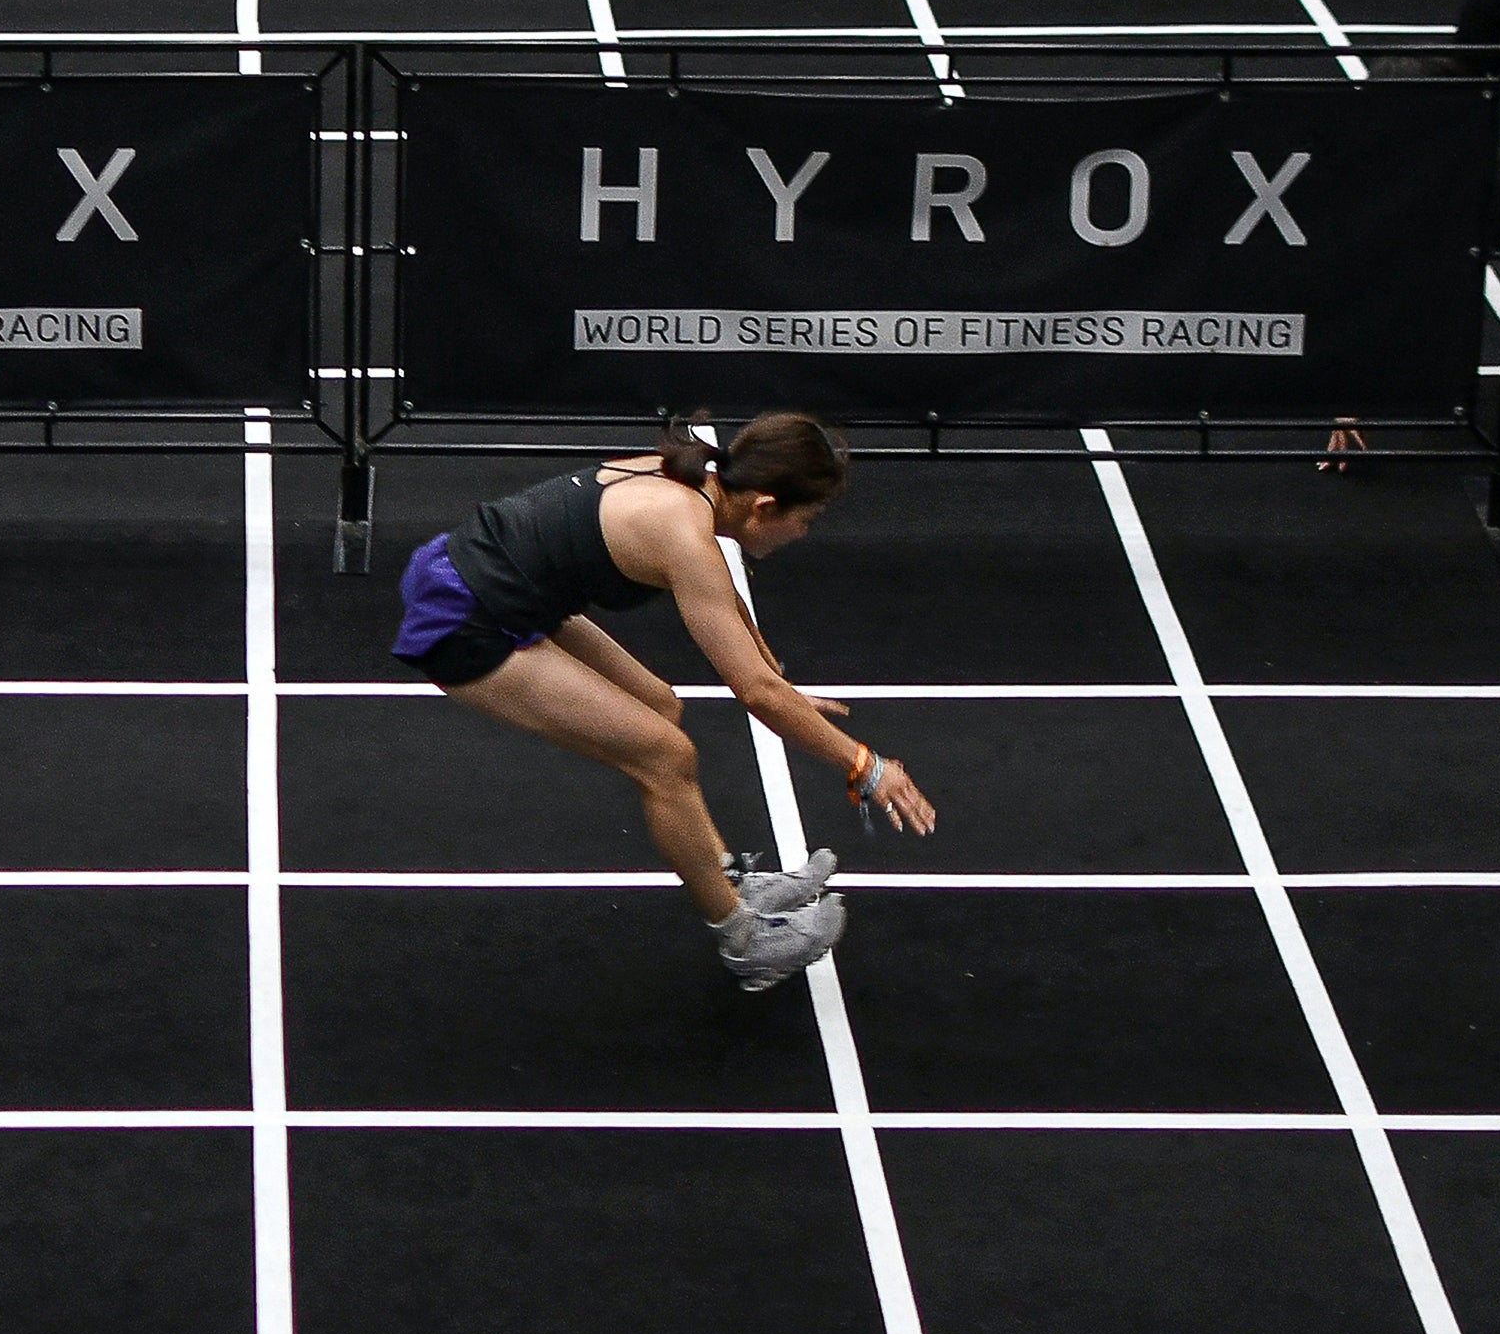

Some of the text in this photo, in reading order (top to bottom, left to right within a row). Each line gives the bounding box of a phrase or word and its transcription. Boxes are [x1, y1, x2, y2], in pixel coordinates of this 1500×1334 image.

[580, 147, 1311, 247] HYROX
[583, 316, 1292, 349] WORLD SERIES OF FITNESS RACING
